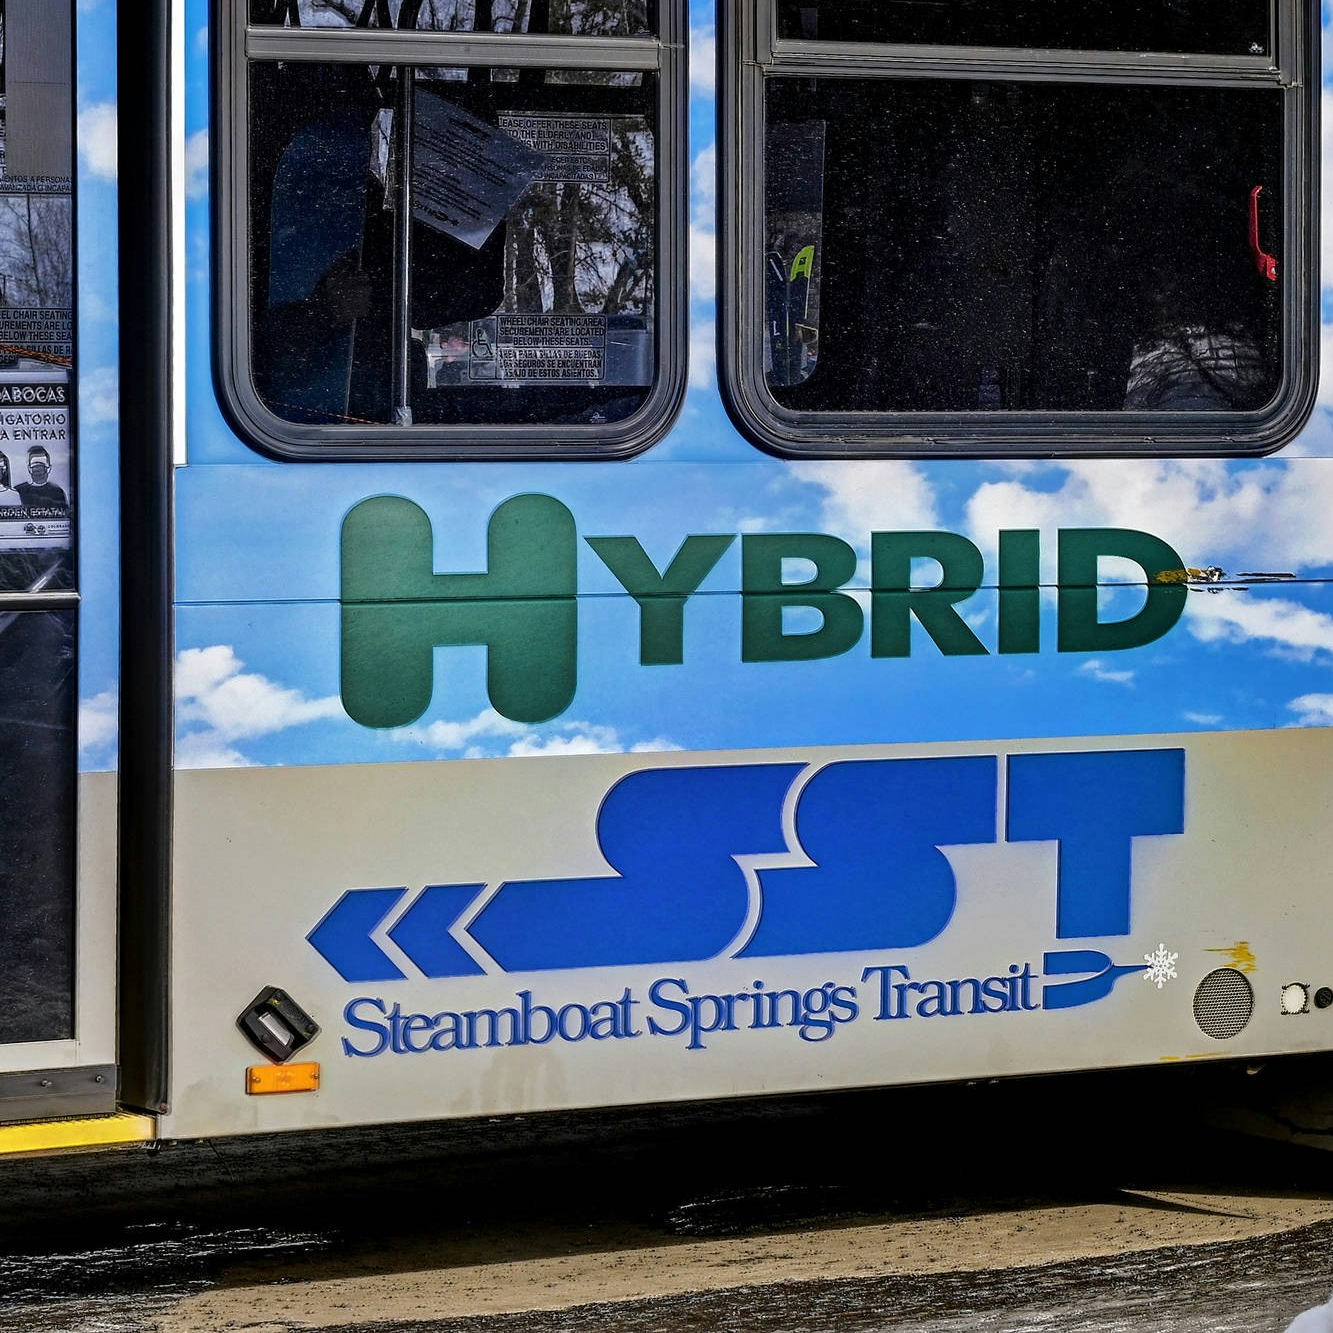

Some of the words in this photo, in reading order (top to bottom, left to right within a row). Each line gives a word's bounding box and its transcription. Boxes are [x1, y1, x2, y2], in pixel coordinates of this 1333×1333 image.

[554, 120, 580, 129] THESE
[581, 121, 607, 130] SEATS
[520, 129, 536, 138] THE
[538, 130, 573, 139] ELDERLY
[575, 131, 592, 140] AND
[555, 141, 607, 151] DISABILITIES
[13, 310, 37, 319] CHAIR
[44, 321, 60, 330] ARE
[500, 317, 526, 326] WHEEL
[550, 317, 580, 326] SEATING
[583, 317, 604, 326] AREA
[28, 331, 54, 340] THESE
[500, 327, 553, 335] SECUREMENTS
[555, 327, 570, 336] ARE
[571, 327, 605, 336] LOCATED
[513, 337, 540, 345] BELOW
[541, 337, 565, 345] THESE
[528, 369, 537, 377] DE
[539, 369, 560, 377] ESTOS
[13, 428, 66, 440] ENTRAR
[340, 493, 1188, 729] HYBRID
[575, 748, 1185, 964] SST
[341, 987, 641, 1057] Steamboat
[647, 977, 860, 1050] Springs
[863, 960, 1042, 1020] Transit
